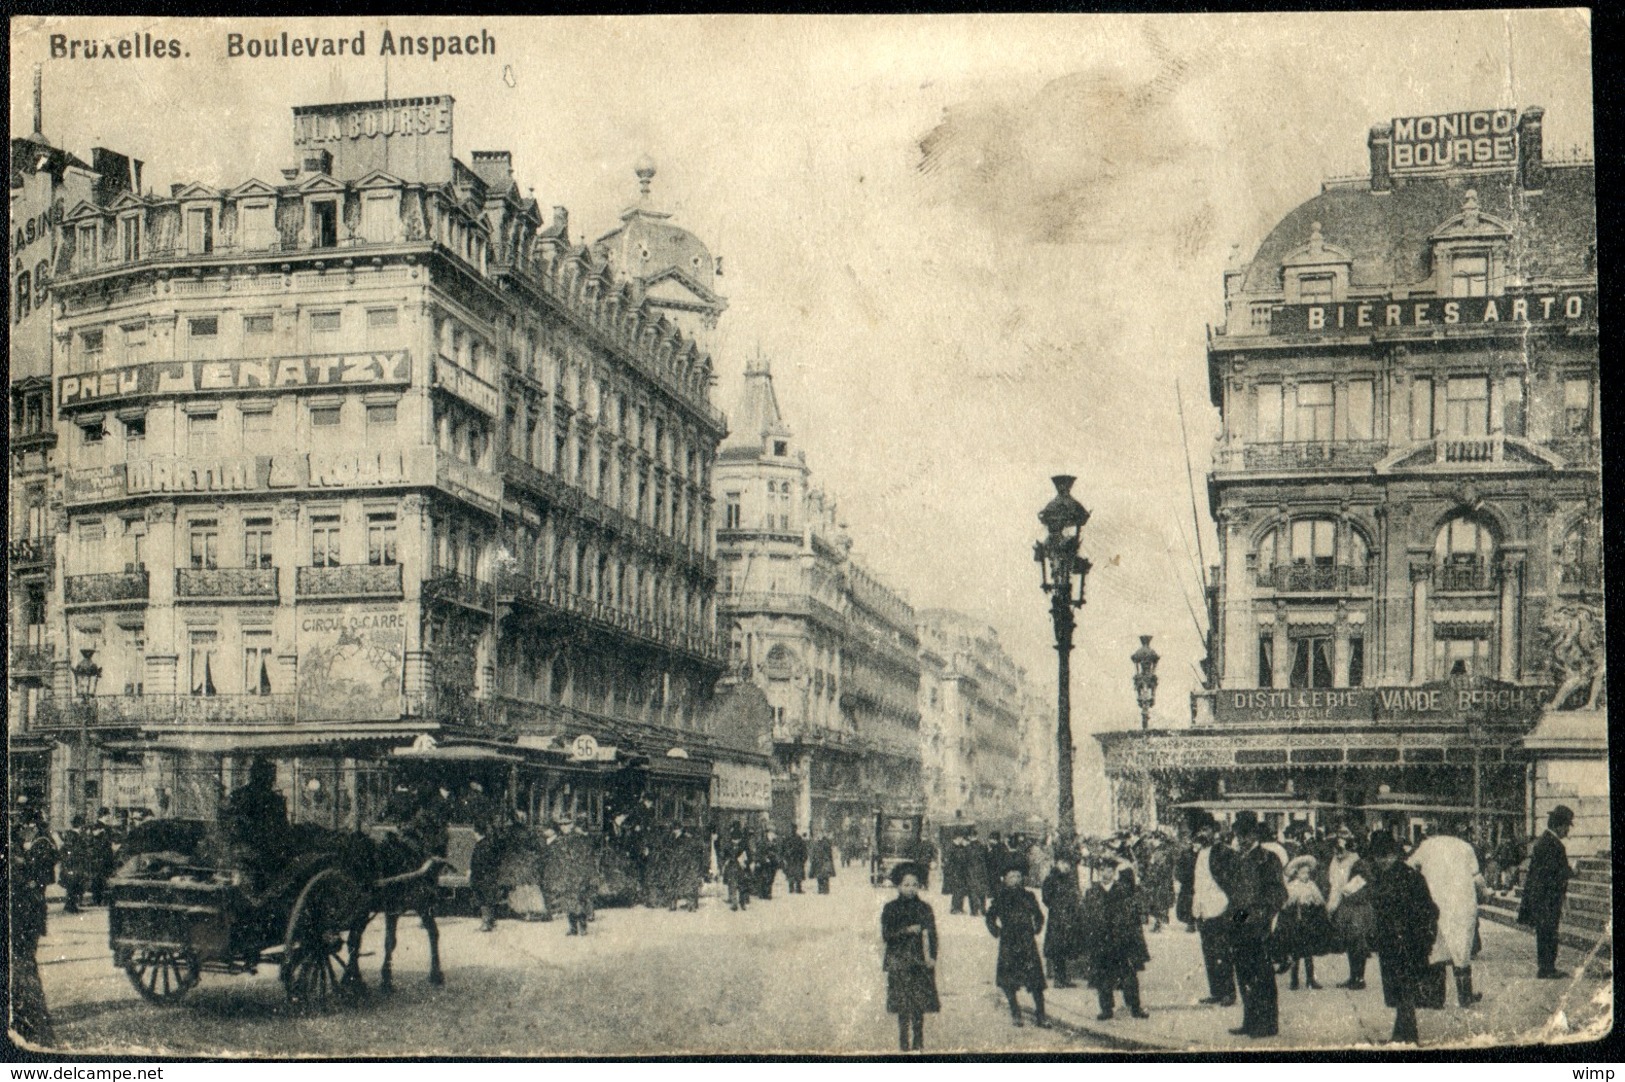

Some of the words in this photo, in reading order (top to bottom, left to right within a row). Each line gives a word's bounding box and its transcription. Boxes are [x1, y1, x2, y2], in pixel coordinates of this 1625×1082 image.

[49, 32, 191, 59] Bruxelles.
[227, 30, 365, 58] Boulevard
[379, 29, 496, 62] Anspach
[350, 103, 451, 141] BOURSE
[1395, 110, 1513, 142] MONICO
[1394, 136, 1514, 167] BOURSE
[1483, 295, 1584, 322] ARTO
[61, 369, 139, 404] PNEU
[157, 352, 405, 393] JENATZY
[127, 456, 257, 496] MARTINI
[1234, 690, 1359, 709] DISTILLERIE
[577, 738, 594, 757] 56
